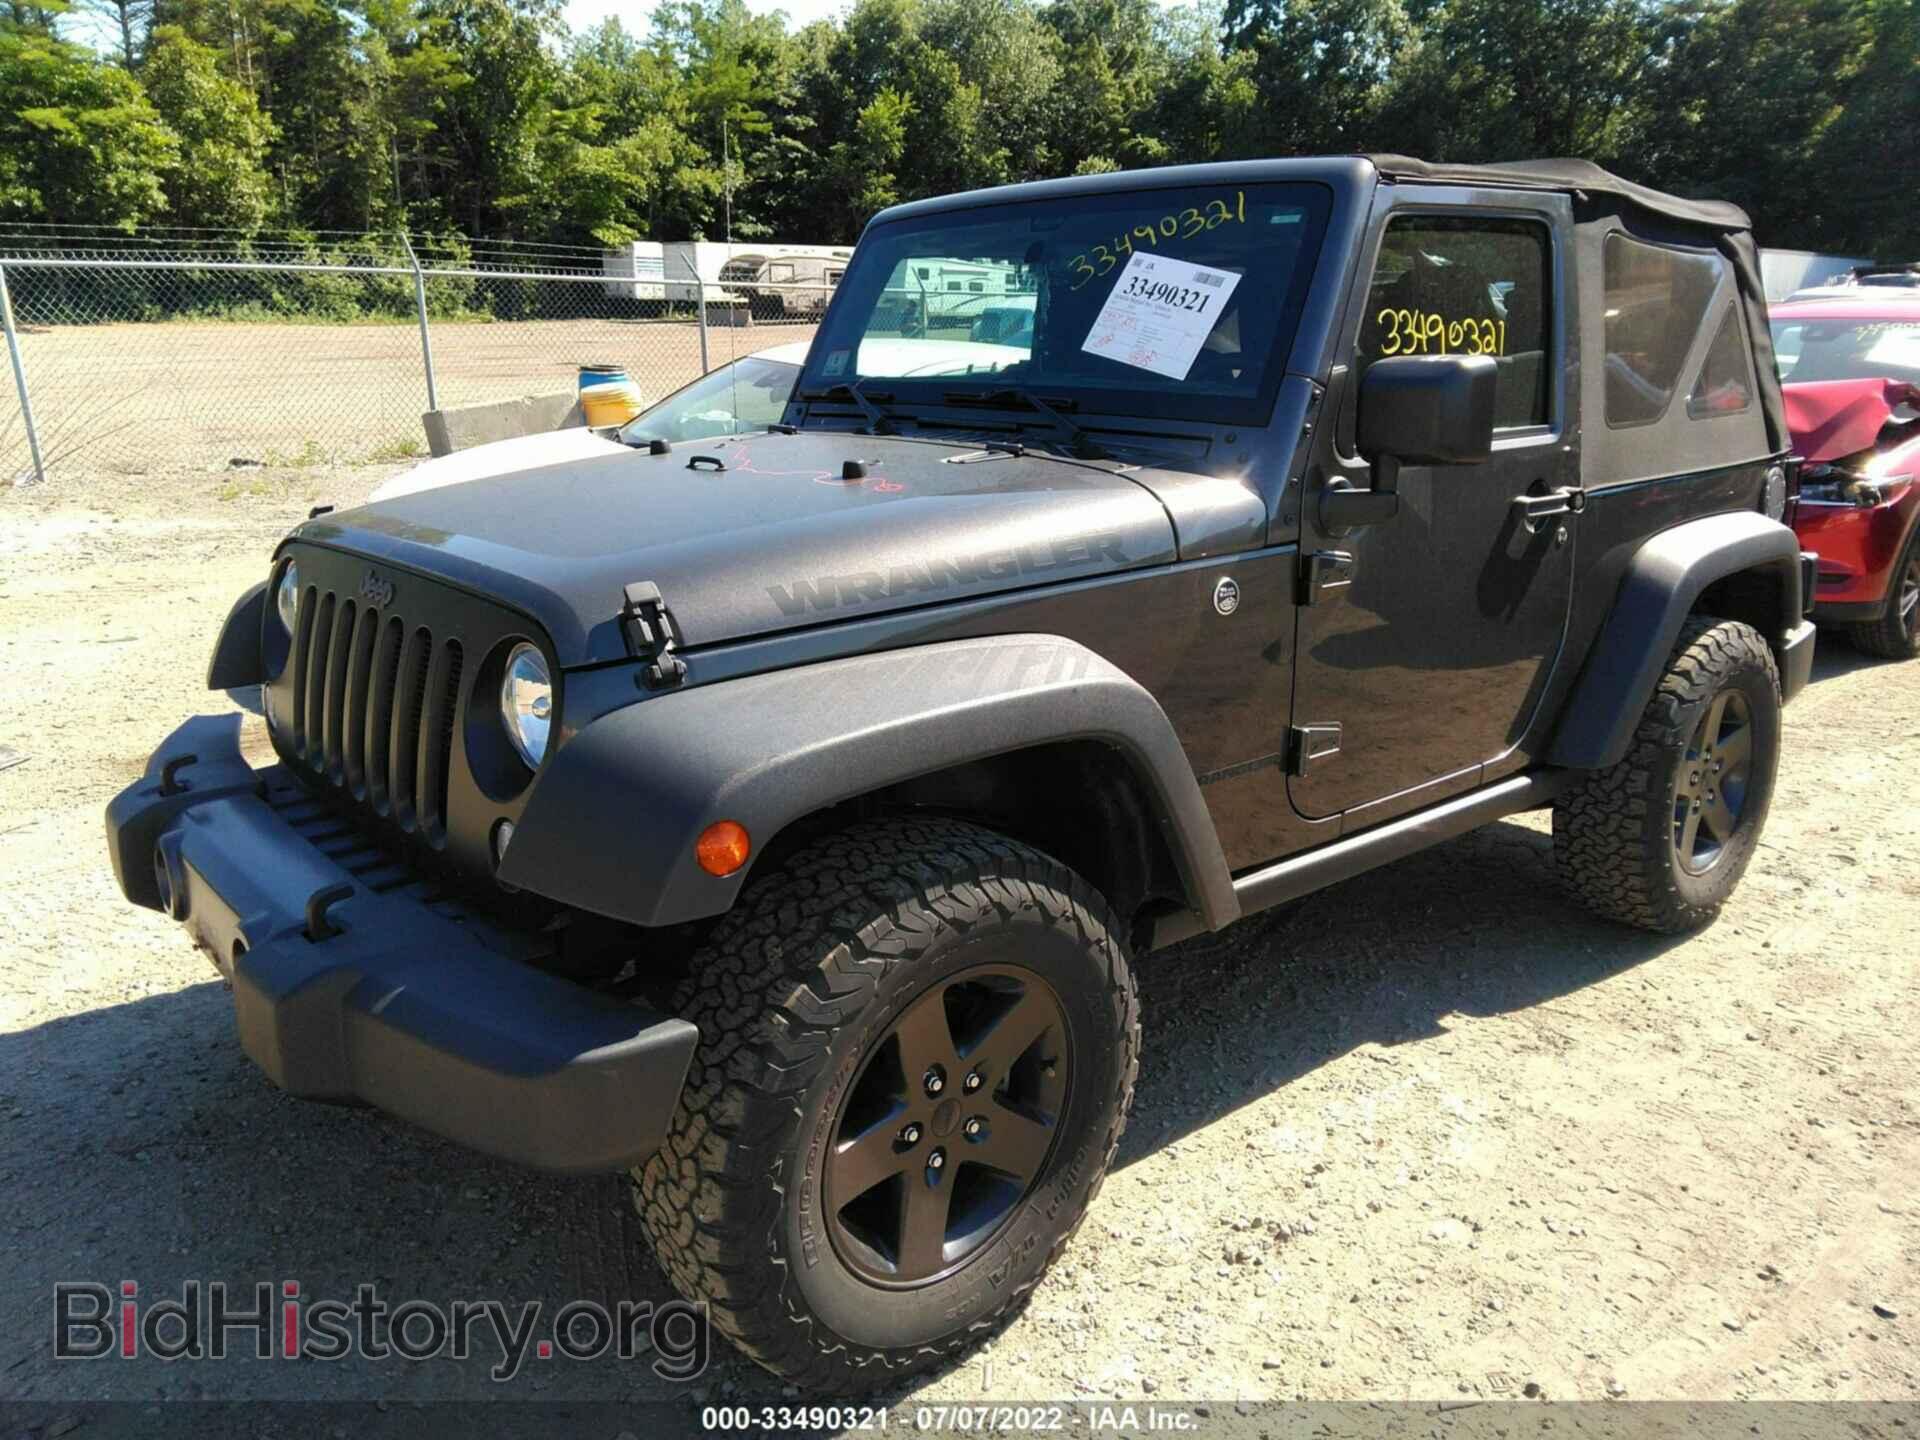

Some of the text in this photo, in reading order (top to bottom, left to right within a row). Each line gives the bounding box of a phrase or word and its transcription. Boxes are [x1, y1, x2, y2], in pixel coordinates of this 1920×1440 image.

[1069, 191, 1246, 290] 33490321
[1123, 276, 1211, 313] 33490321
[1378, 308, 1505, 357] 33490321
[767, 533, 1130, 616] WRANGLER
